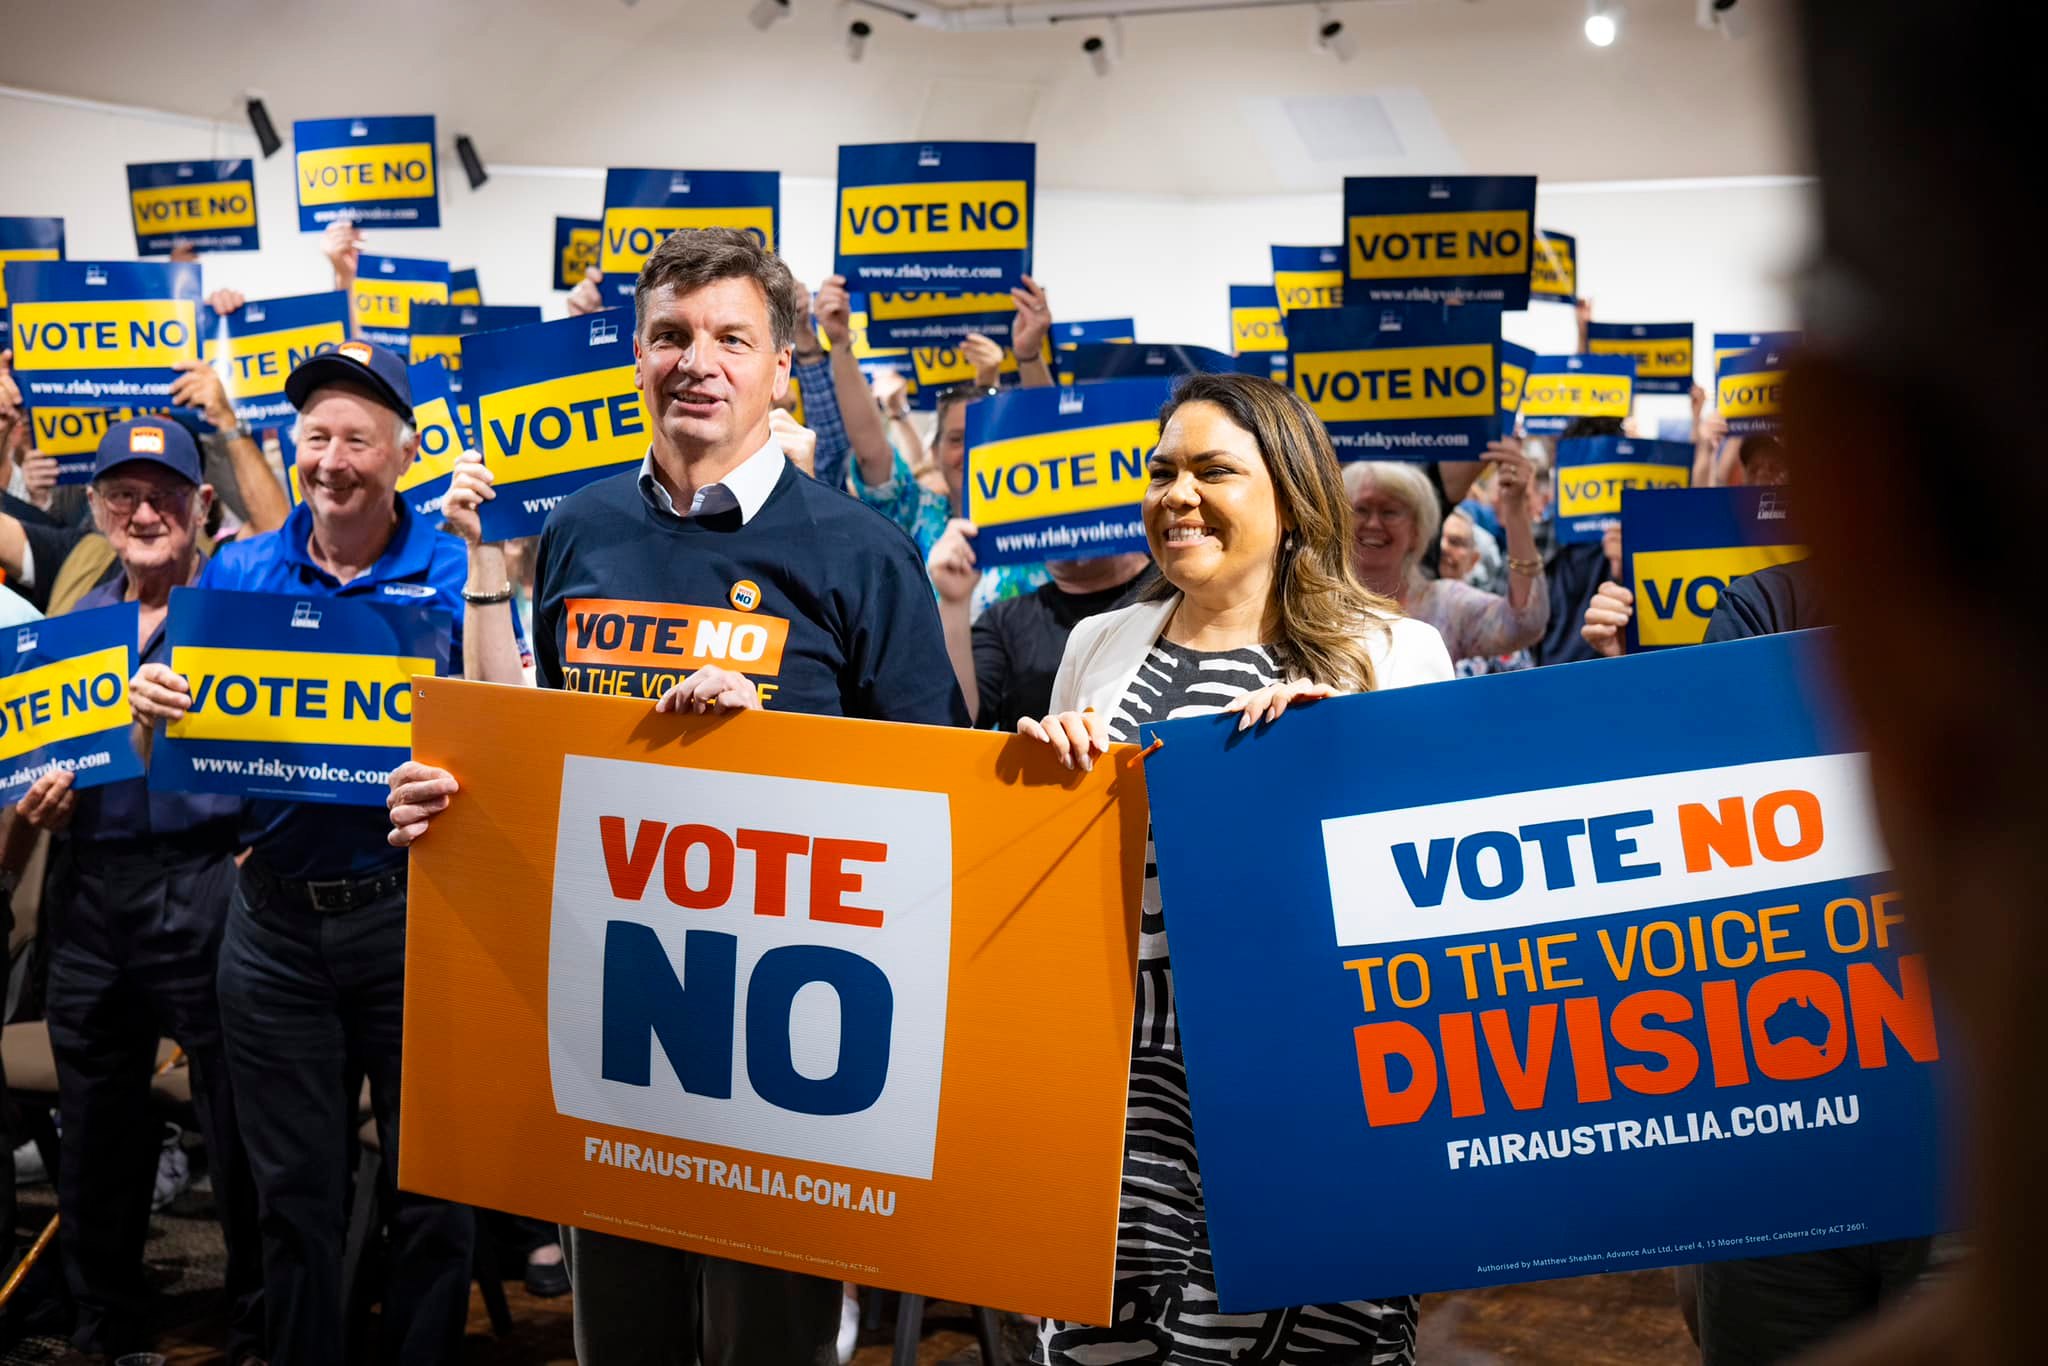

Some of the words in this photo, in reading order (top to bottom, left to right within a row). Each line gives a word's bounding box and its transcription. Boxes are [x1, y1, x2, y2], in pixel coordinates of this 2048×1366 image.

[304, 164, 374, 188] VOTE
[383, 160, 426, 183] NO
[137, 198, 201, 221] VOTE
[208, 194, 248, 215] NO
[848, 203, 949, 236] VOTE
[961, 201, 1019, 231] NO
[608, 227, 690, 255] VO
[1355, 232, 1459, 262] VOTE
[1468, 229, 1521, 258] NO
[858, 265, 1002, 281] www.riskyvoice.com
[356, 293, 401, 314] OTE
[18, 321, 119, 351] VOTE
[129, 320, 189, 348] NO
[1301, 368, 1412, 403] VOTE
[1424, 365, 1486, 399] NO
[489, 392, 644, 457] VOTE
[976, 453, 1098, 501] VOTE
[996, 520, 1147, 552] www.riskyvoice.co
[735, 592, 752, 605] NO
[1643, 575, 1746, 620] VO
[575, 612, 689, 656] VOTE
[693, 619, 768, 662] NO
[62, 672, 122, 717] NO
[182, 674, 329, 719] VOTE
[586, 668, 636, 697] THE
[1390, 809, 1662, 908] VOTE
[1677, 789, 1825, 873] NO
[599, 815, 888, 928] VOTE
[1343, 952, 1431, 1013] TO
[1445, 932, 1584, 1001] THE
[1597, 903, 1806, 982] VOICE
[1824, 891, 1906, 954] OF
[602, 920, 894, 1116] NO
[1353, 954, 1940, 1128] DIVISION
[1446, 1095, 1861, 1171] FAIRAUSTRALIA.COM.AU
[584, 1136, 896, 1216] FAIRAUSTRALIA.COM.AU
[1477, 1262, 1520, 1273] Authorised
[1521, 1260, 1531, 1270] by
[1532, 1256, 1567, 1267] Matthew
[1606, 1248, 1640, 1259] Advance
[1641, 1246, 1657, 1256] Aus
[1674, 1242, 1696, 1252] Level
[1706, 1239, 1716, 1248] 15
[1717, 1237, 1744, 1248] Moore
[1773, 1229, 1809, 1241] Canberra
[1810, 1227, 1827, 1238] City
[1828, 1224, 1845, 1234] ACT
